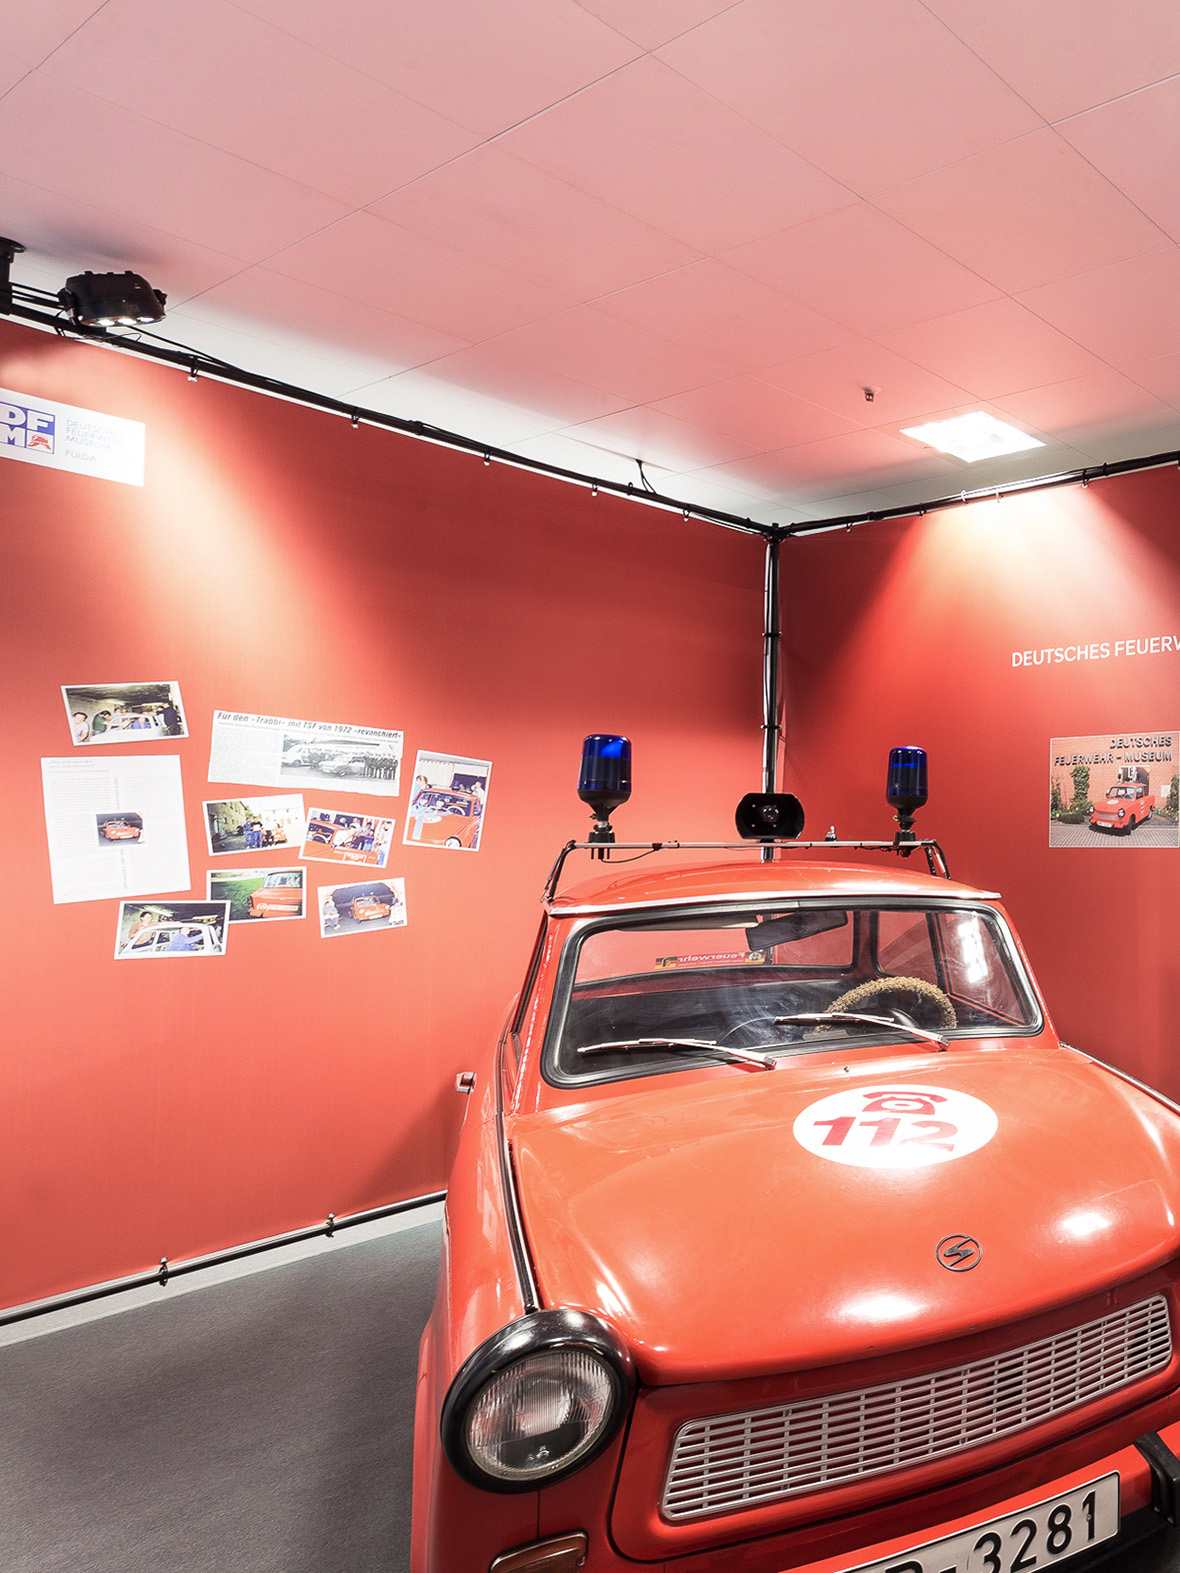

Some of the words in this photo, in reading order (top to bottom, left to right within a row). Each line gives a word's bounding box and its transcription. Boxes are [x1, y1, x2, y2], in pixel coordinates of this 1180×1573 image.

[65, 449, 97, 462] FULDA
[1011, 642, 1111, 668] DEUTSCHES
[233, 714, 249, 722] den
[288, 720, 302, 728] mit
[303, 721, 317, 730] TSF
[318, 724, 333, 732] von
[334, 725, 353, 734] 1972
[1110, 736, 1172, 749] DEUTSCHES
[1054, 752, 1114, 767] FEUERWEHR
[1124, 750, 1173, 763] MUSEUM
[813, 1116, 958, 1152] 112
[973, 1489, 1096, 1573] 3281
